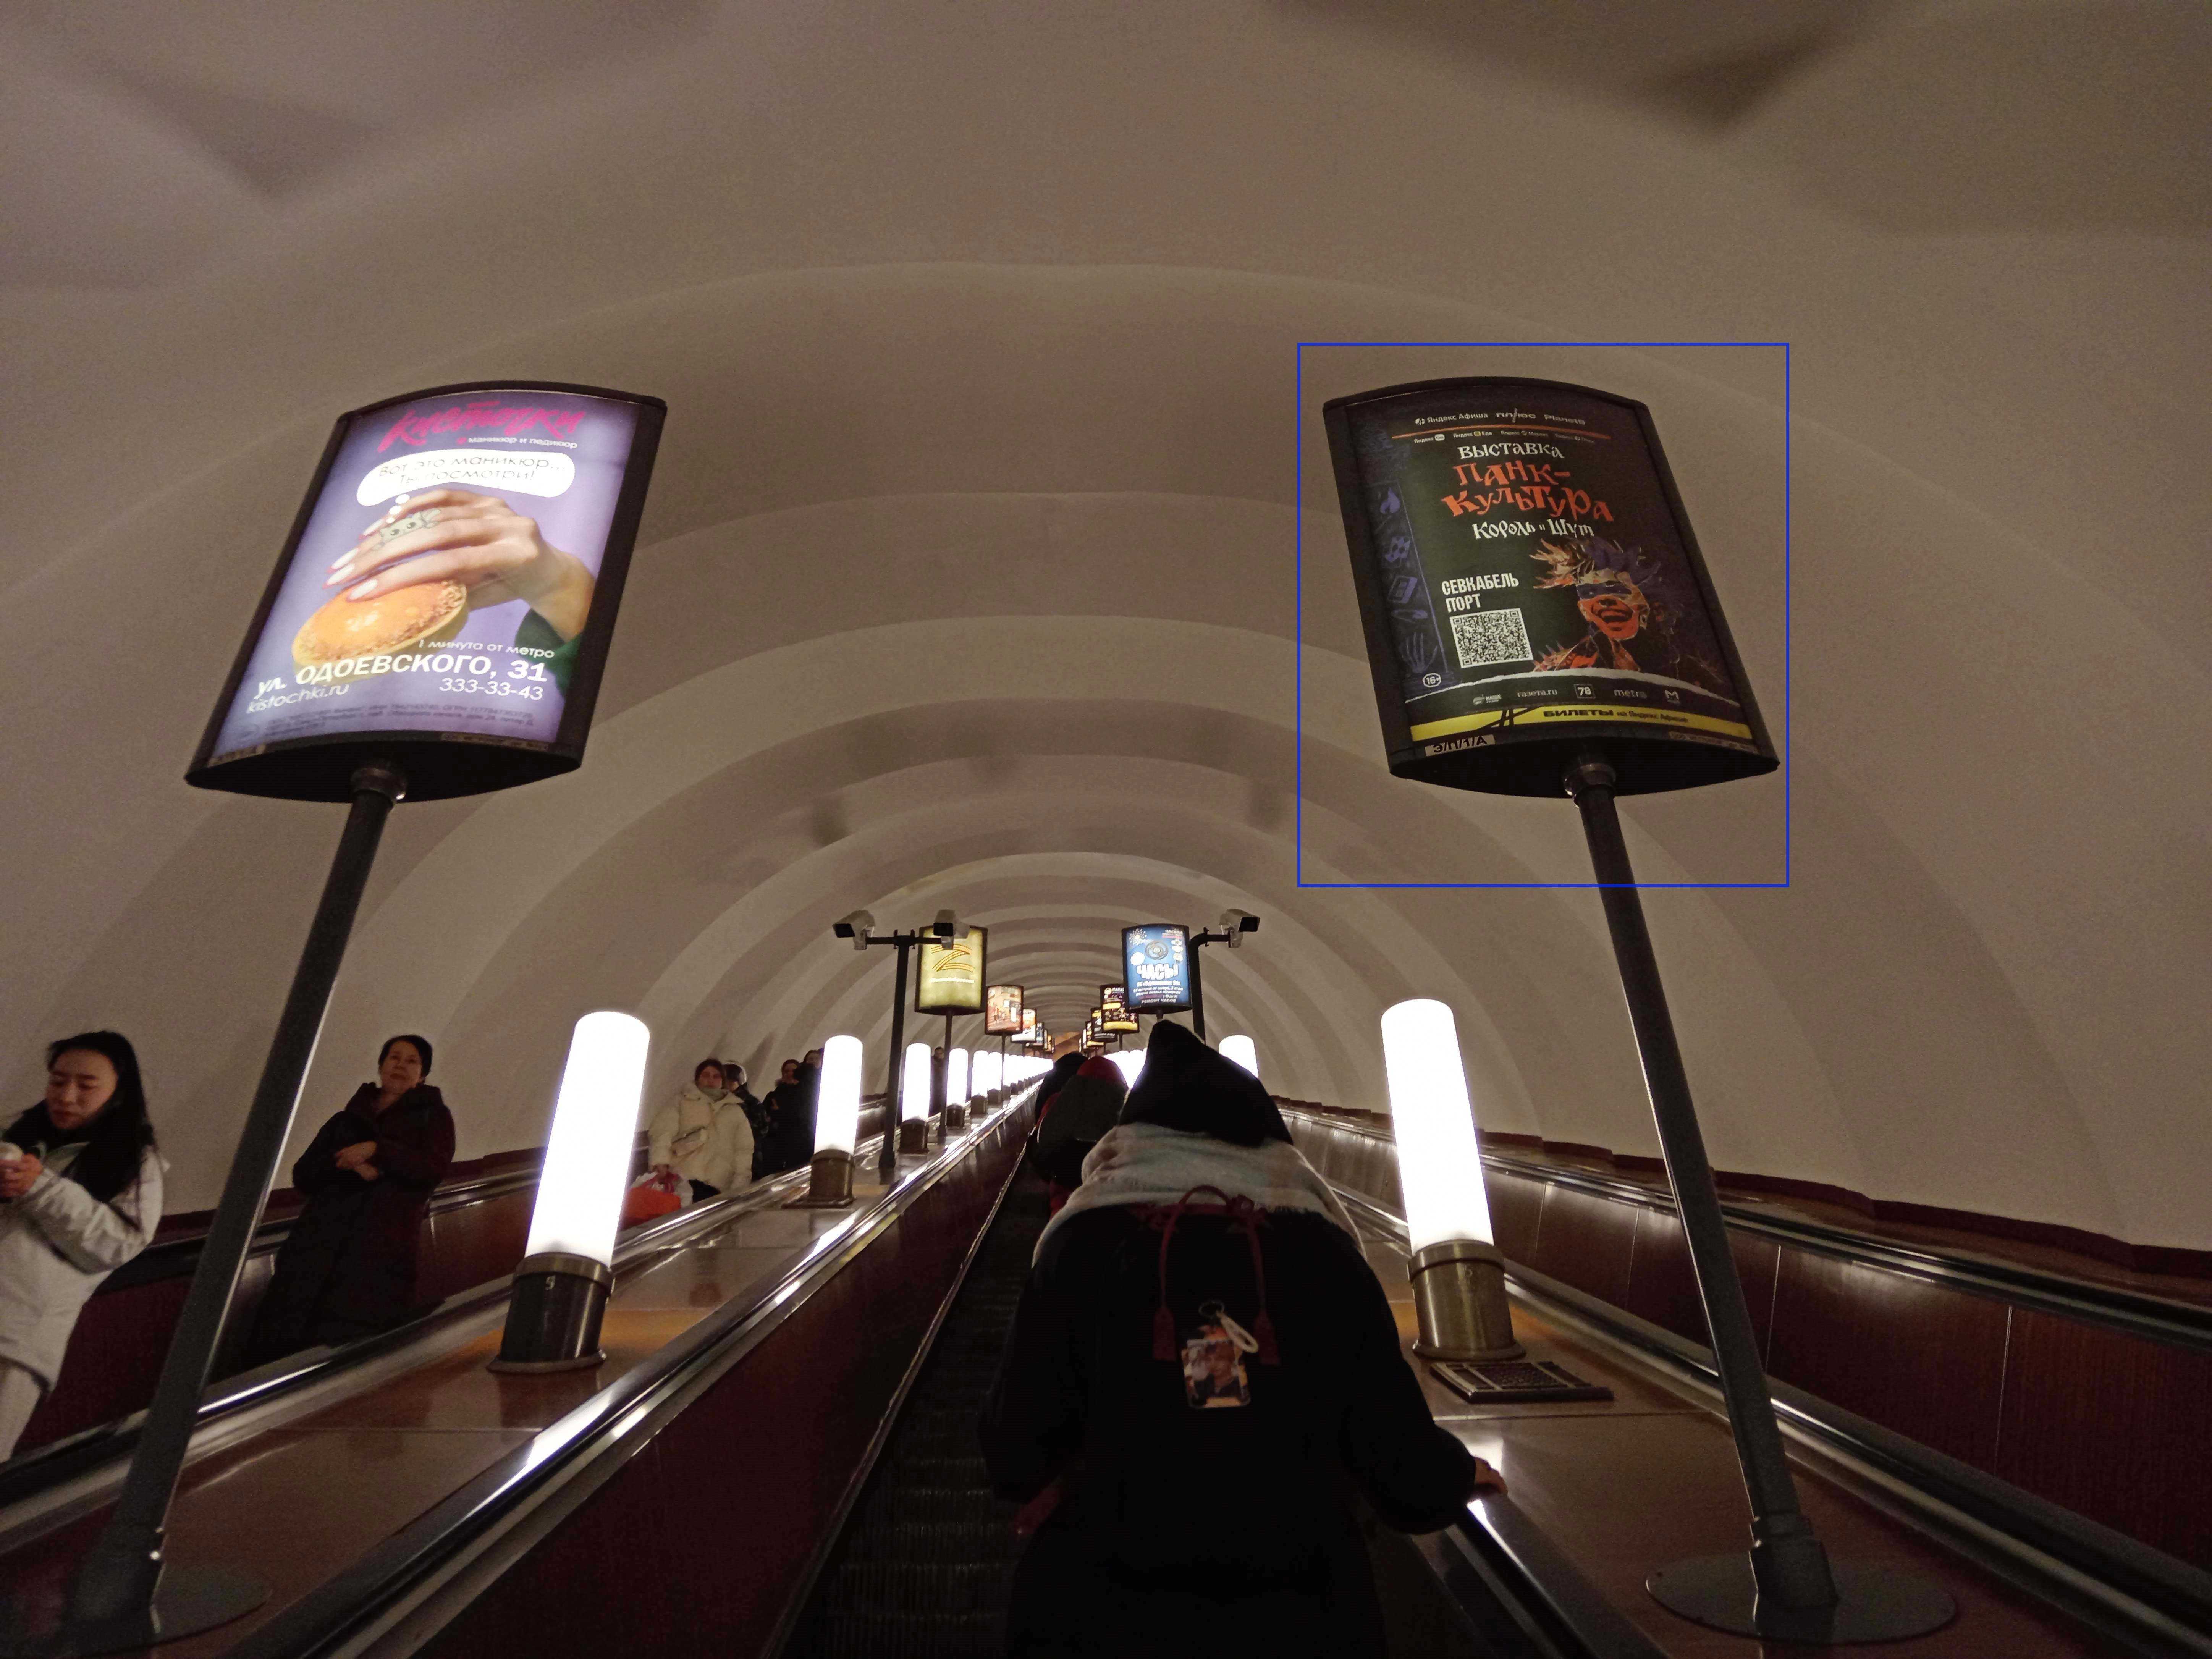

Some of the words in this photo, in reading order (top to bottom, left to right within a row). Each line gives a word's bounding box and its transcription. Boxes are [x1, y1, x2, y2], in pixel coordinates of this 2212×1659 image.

[1427, 415, 1457, 423] Яндекс
[468, 437, 517, 445] маникюр
[529, 438, 577, 449] педикюр
[1457, 442, 1565, 459] ВЫСТАВКА
[379, 464, 406, 477] Вот
[414, 459, 445, 470] это
[1452, 460, 1571, 486] ПАНК-
[1472, 519, 1536, 539] Король
[1547, 518, 1595, 538] Шут
[1441, 572, 1520, 596] СЕВКАБЕЛЬ
[1445, 593, 1481, 613] ПОРТ
[428, 641, 483, 651] минута
[487, 643, 503, 652] от
[505, 645, 555, 659] метро
[253, 676, 286, 700] ул.
[295, 654, 497, 685] ОДОЕВСКОГО,
[507, 660, 547, 682] 31
[1426, 676, 1439, 684] 16+
[439, 677, 544, 701] 333-33-43
[1577, 686, 1592, 696] 78
[246, 684, 350, 714] kistochki.ru
[1136, 963, 1179, 980] ЧАСЫ
